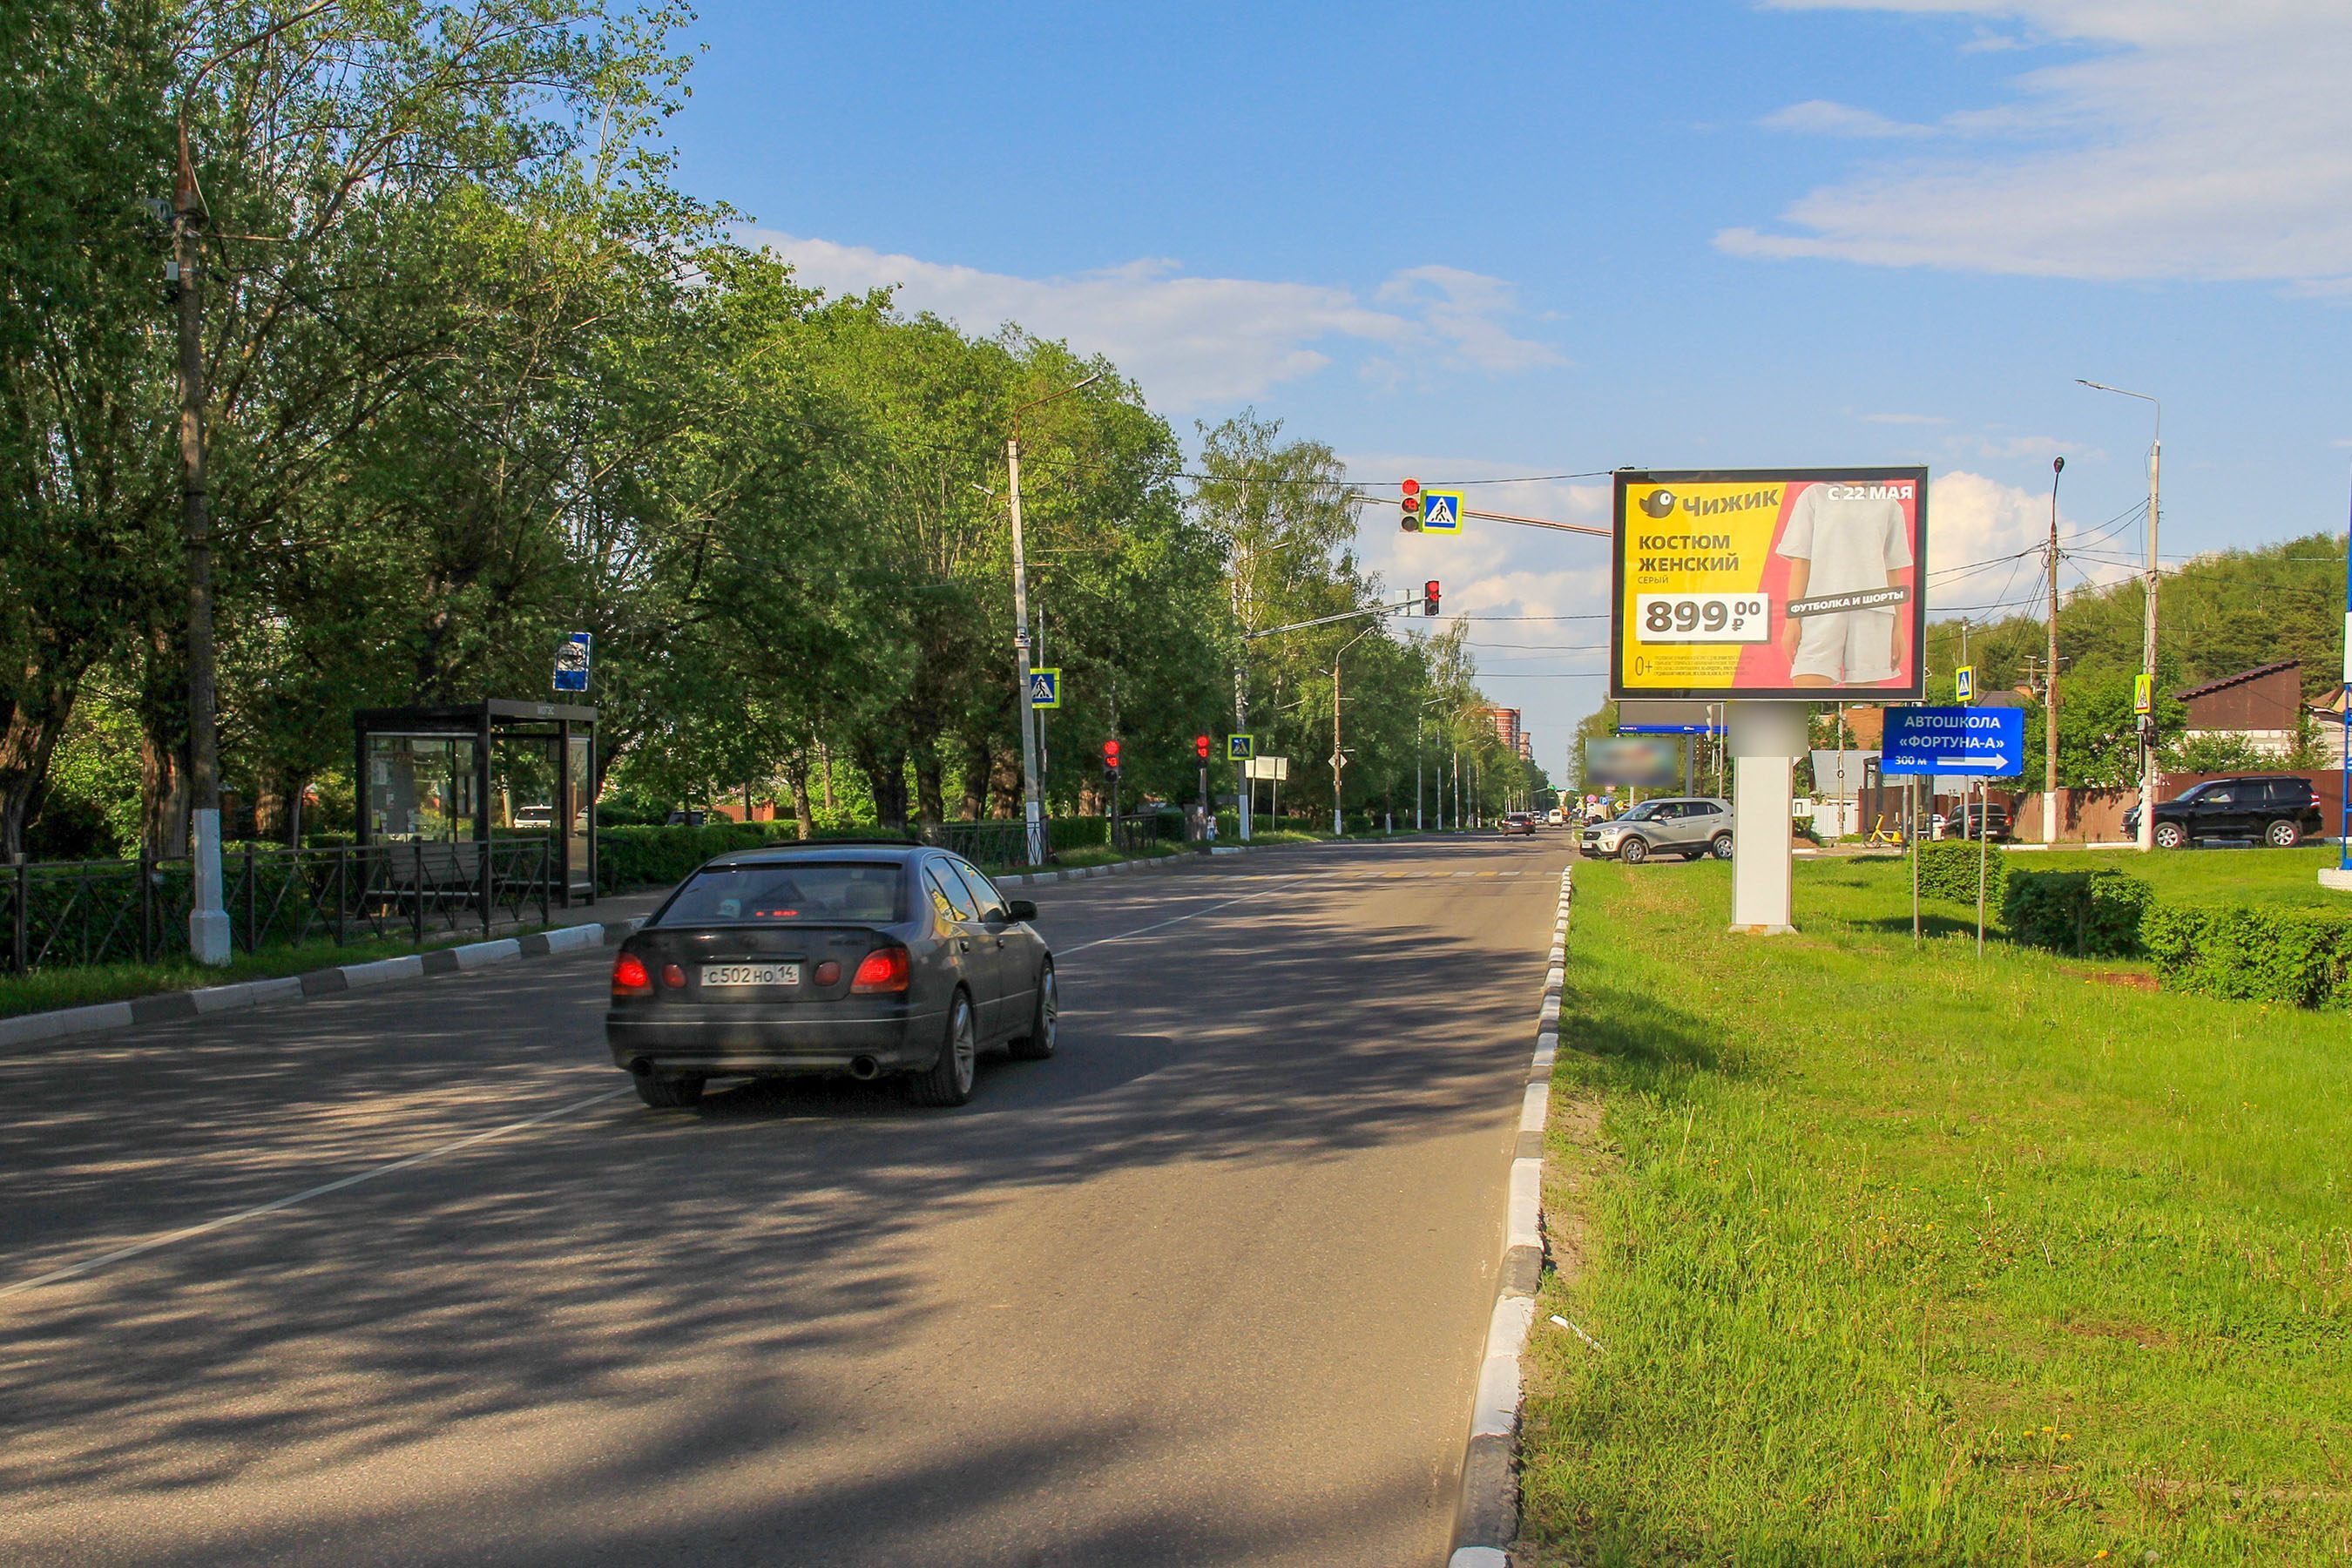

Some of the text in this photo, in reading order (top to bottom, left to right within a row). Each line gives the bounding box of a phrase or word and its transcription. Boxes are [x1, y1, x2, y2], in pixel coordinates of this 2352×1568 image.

[1843, 486, 1865, 500] 22
[1869, 485, 1913, 500] МАЯ
[1639, 535, 1730, 551] КОСТЮМ
[1639, 553, 1739, 571] ЖЕНСКИЙ
[1638, 575, 1669, 585] СЕРЫЙ
[1790, 591, 1904, 613] ФУТБОЛКА И ШОРТЫ
[1646, 600, 1761, 632] 899 00
[1635, 656, 1653, 676] 0+
[1904, 716, 2001, 729] АВТОШКОЛА
[1899, 735, 2004, 749] «ФОРТУНА-А»
[1895, 755, 1915, 766] 300
